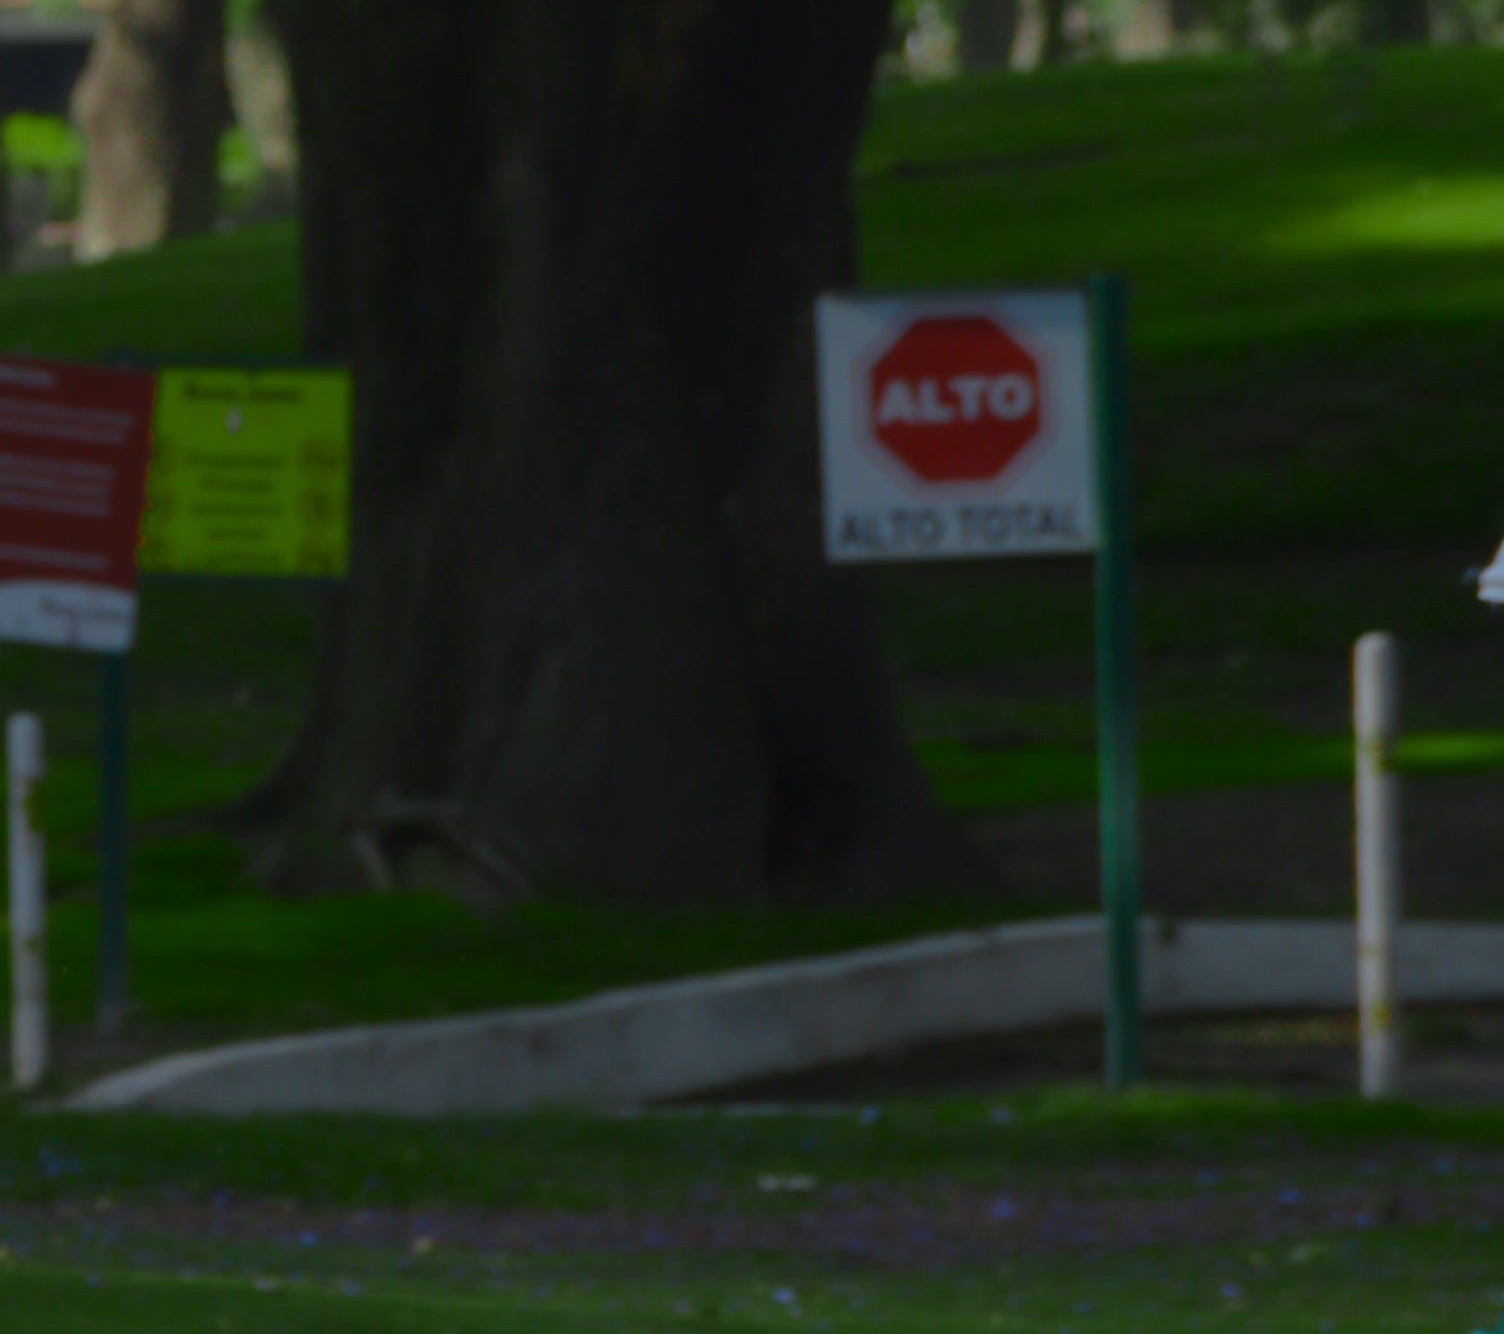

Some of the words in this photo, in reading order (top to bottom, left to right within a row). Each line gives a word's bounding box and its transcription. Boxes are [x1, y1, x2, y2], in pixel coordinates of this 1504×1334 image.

[877, 373, 1034, 425] ALTO
[838, 507, 944, 550] ALTO
[957, 502, 1084, 544] TOTAL
